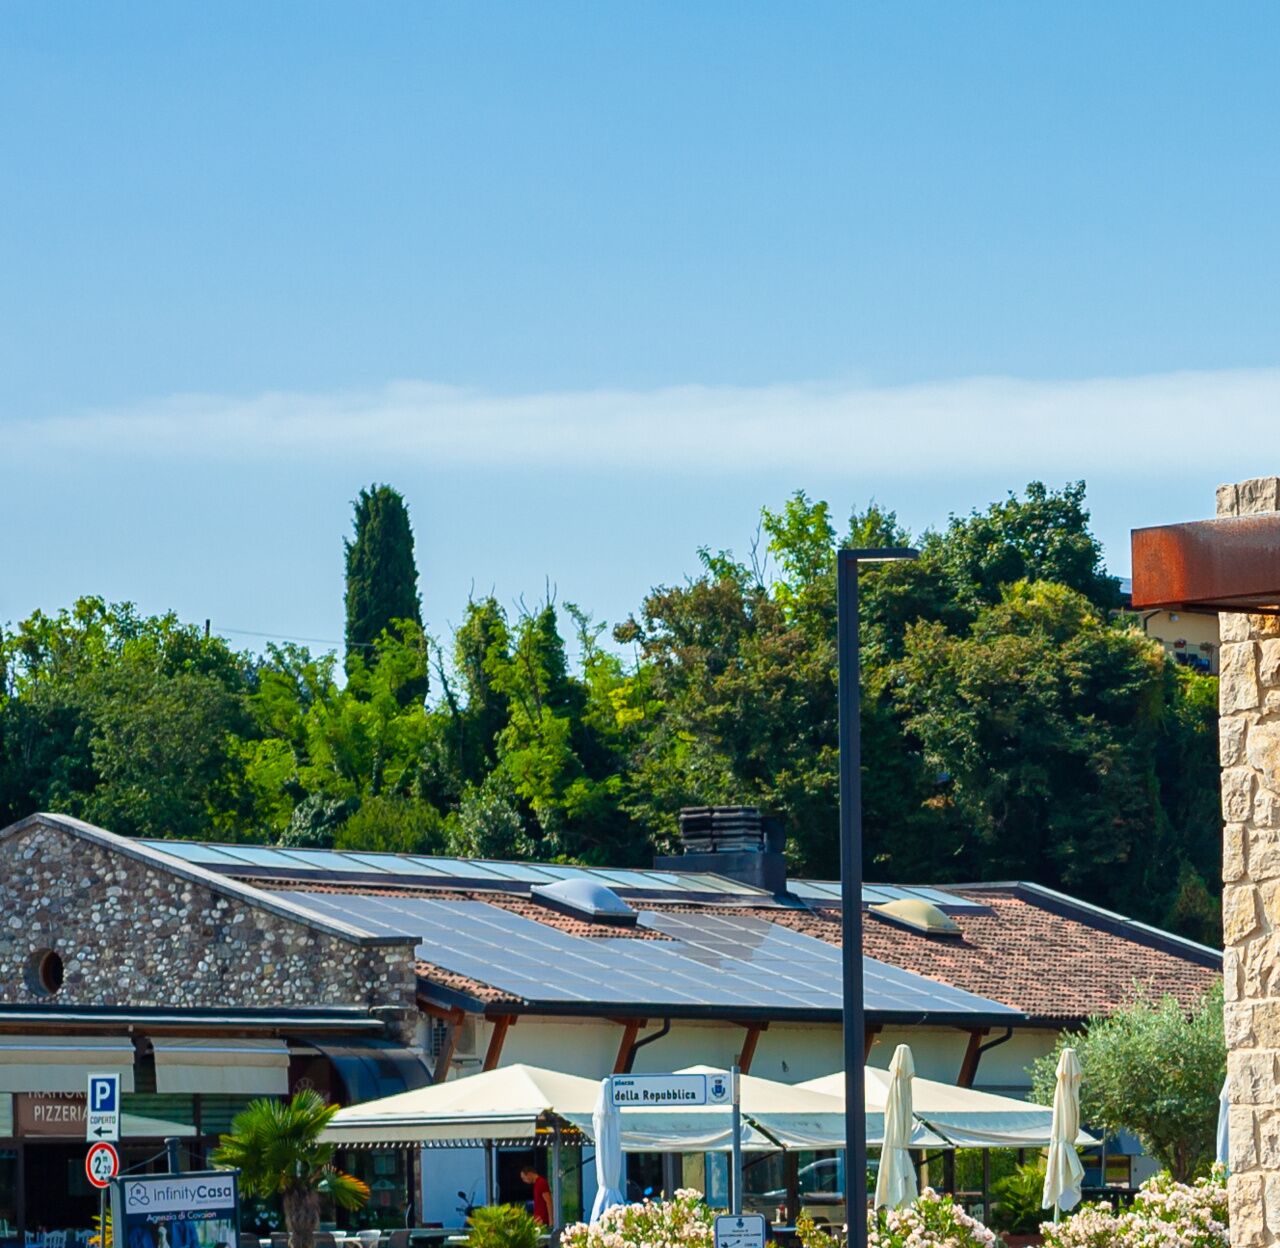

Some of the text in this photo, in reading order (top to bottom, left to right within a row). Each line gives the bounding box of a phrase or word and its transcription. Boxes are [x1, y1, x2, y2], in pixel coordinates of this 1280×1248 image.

[95, 1081, 111, 1109] P
[614, 1089, 696, 1103] della Repubblica
[153, 1185, 232, 1202] InfinityCasa
